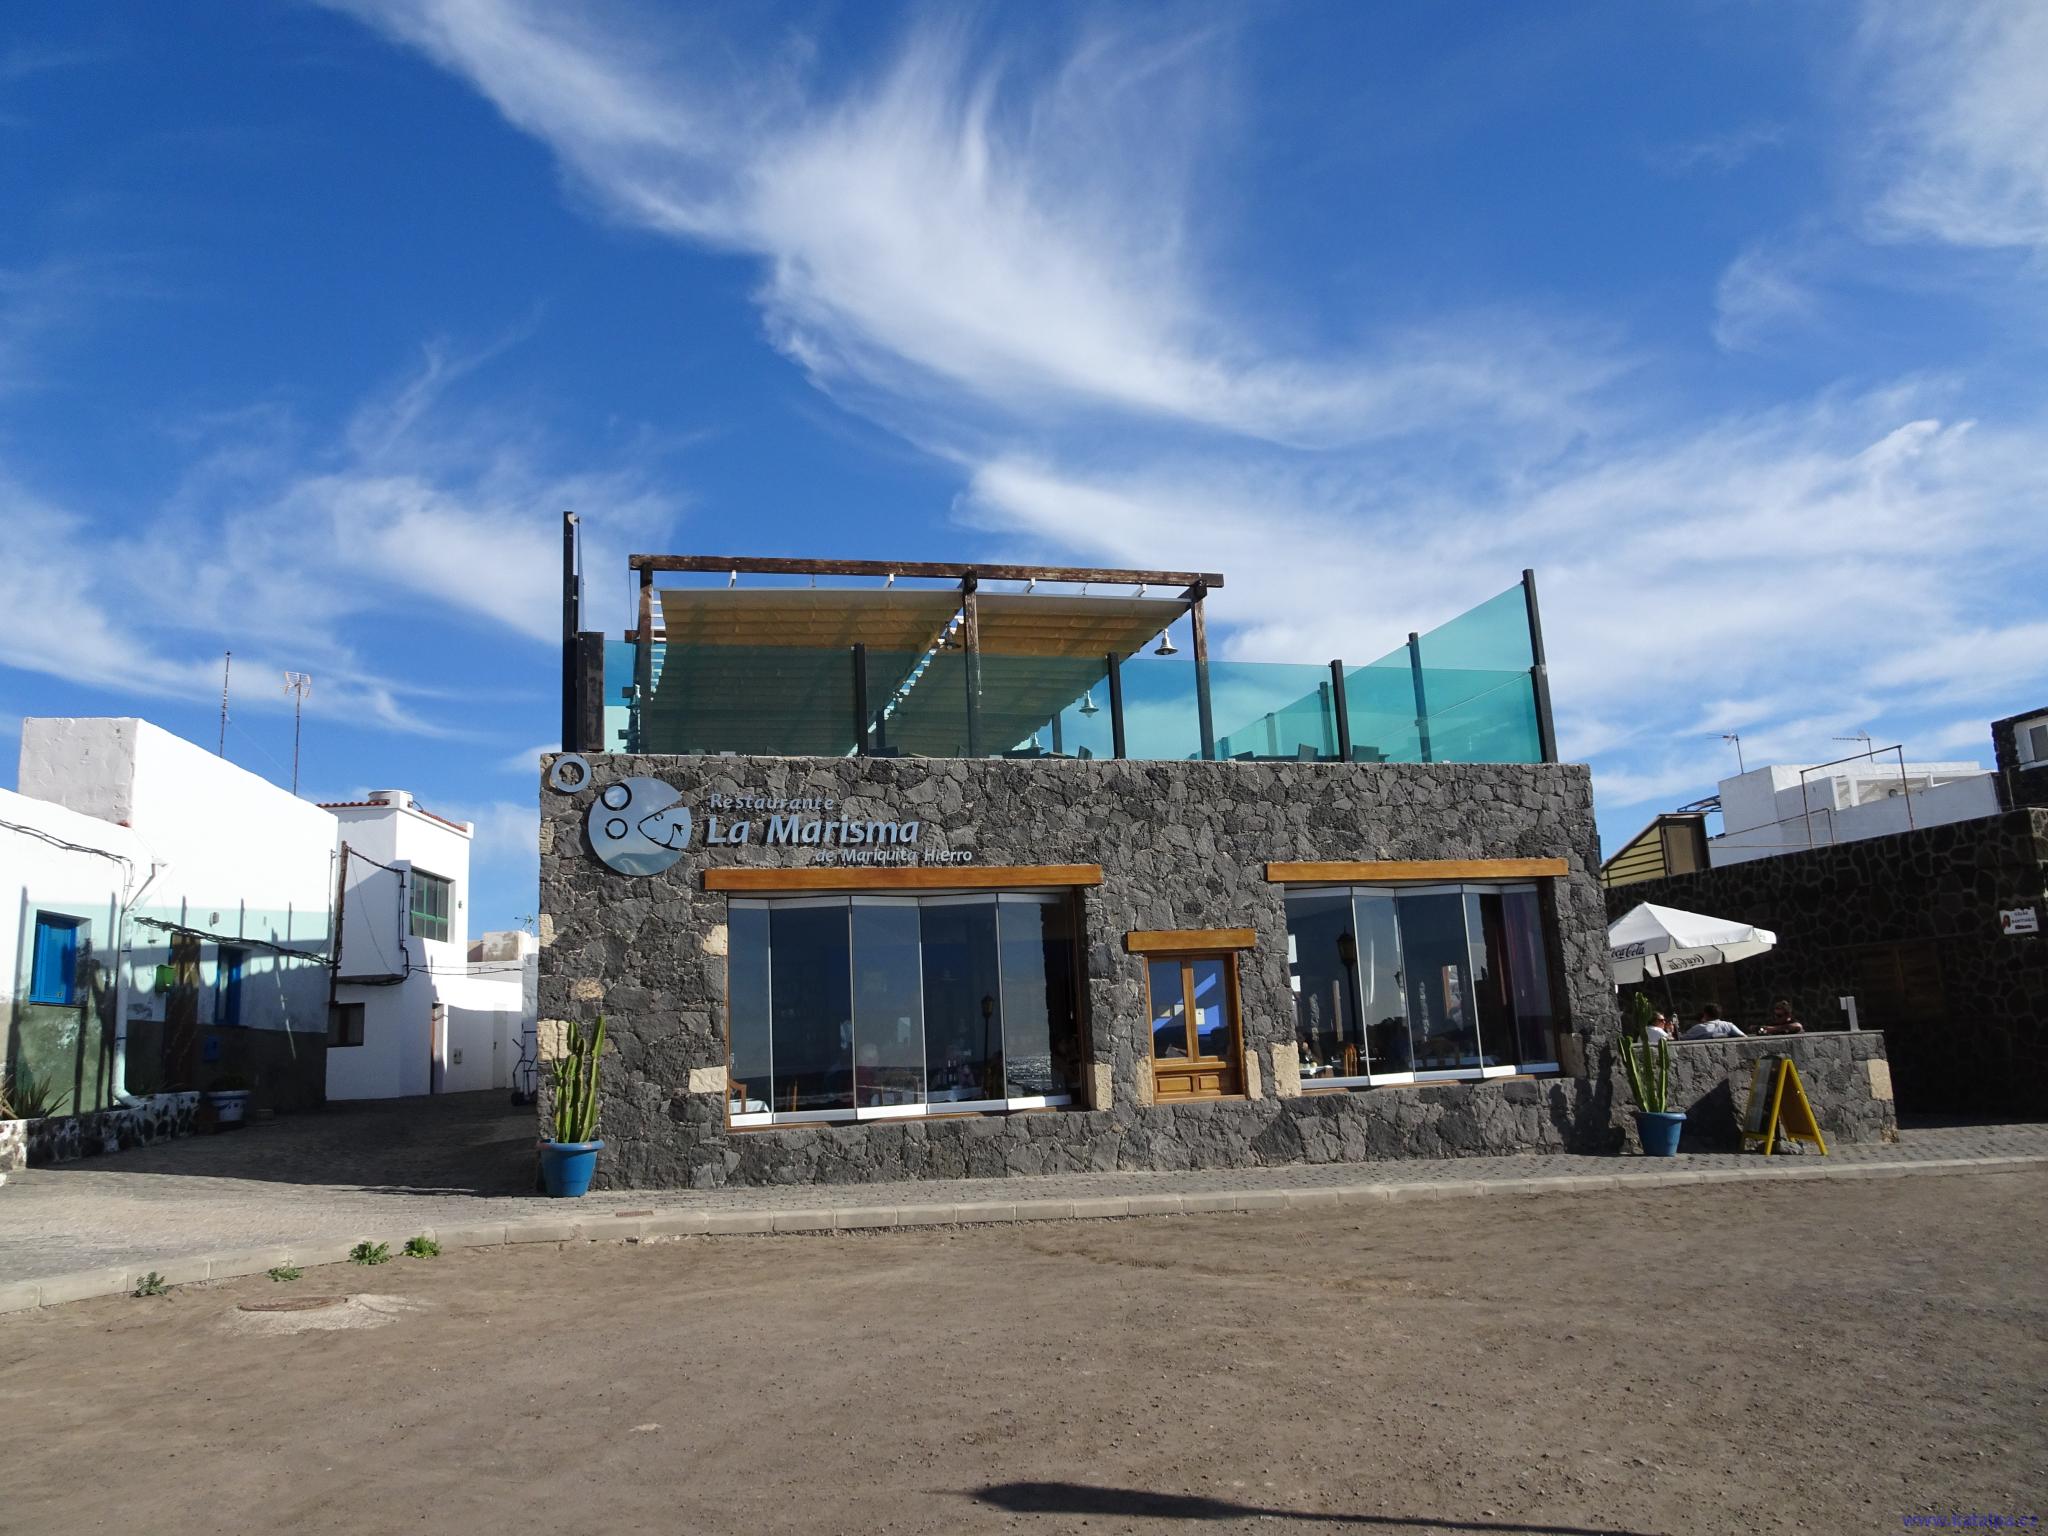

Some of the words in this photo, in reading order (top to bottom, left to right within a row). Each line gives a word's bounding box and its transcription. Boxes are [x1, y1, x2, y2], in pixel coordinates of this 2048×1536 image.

[710, 793, 834, 810] Restaurante
[707, 814, 750, 844] La
[766, 814, 920, 844] Marisma
[815, 848, 834, 862] de
[842, 848, 918, 864] Mariquita
[924, 848, 973, 862] Hierro
